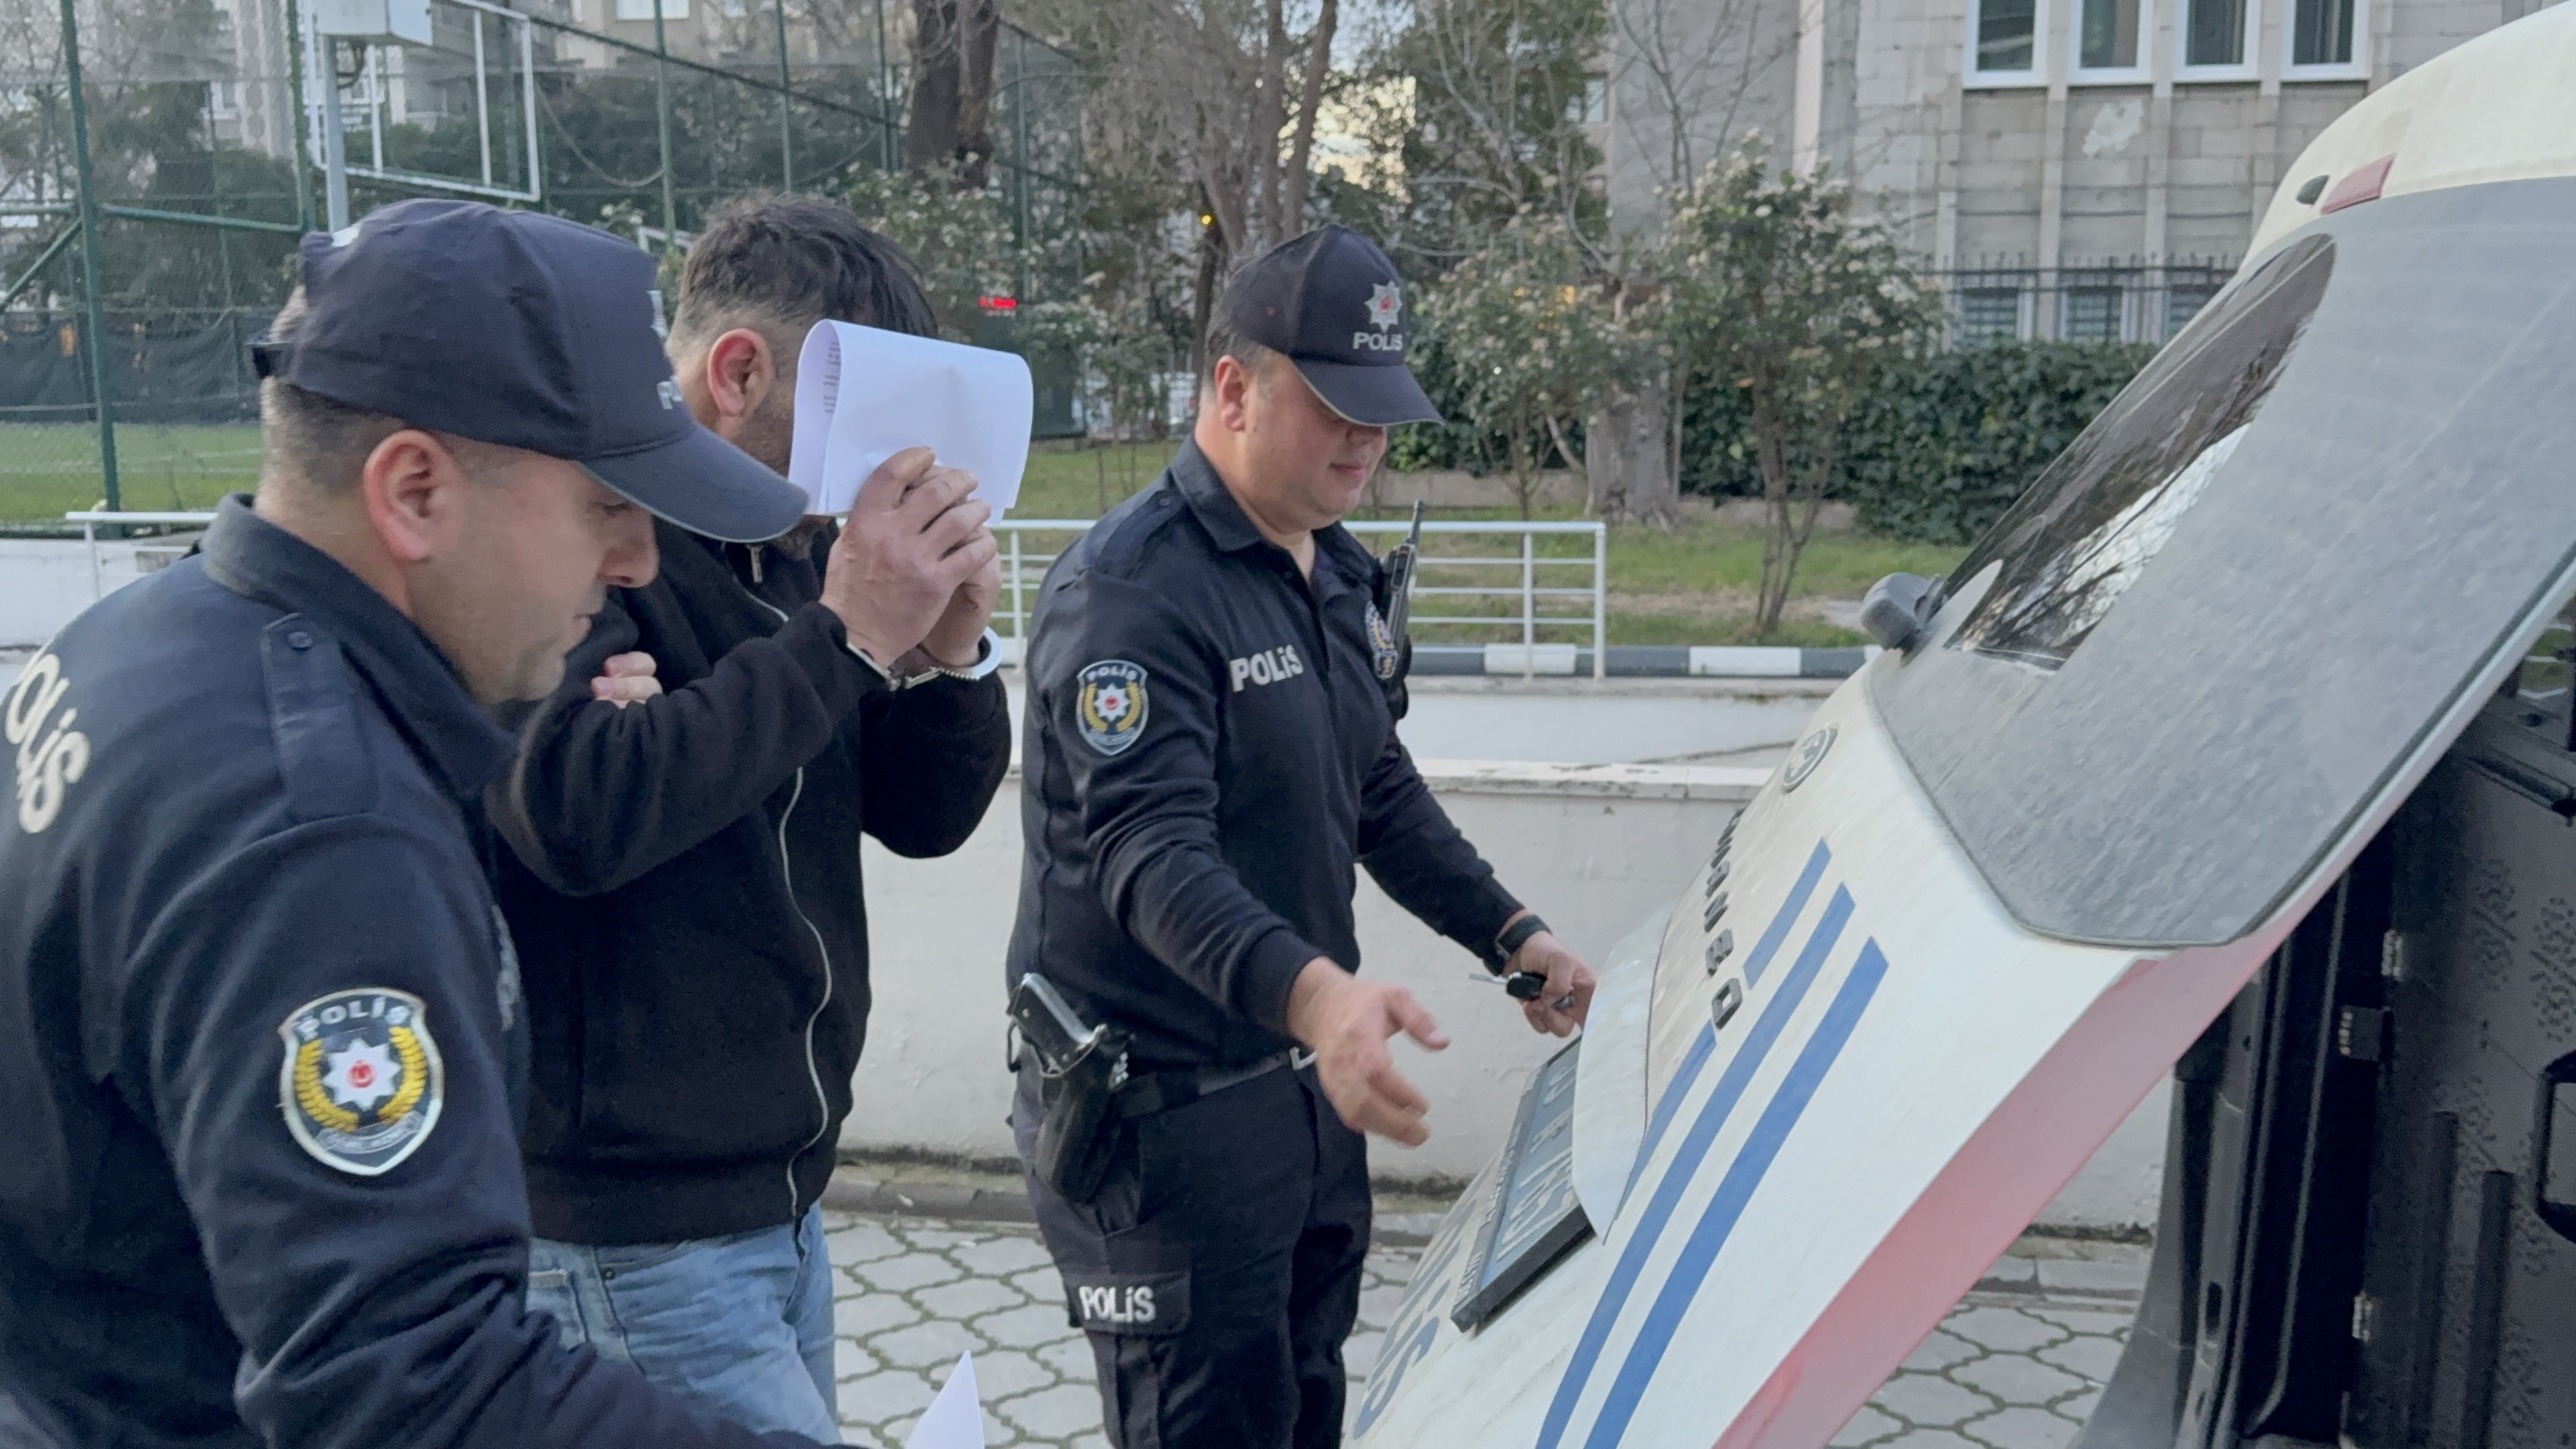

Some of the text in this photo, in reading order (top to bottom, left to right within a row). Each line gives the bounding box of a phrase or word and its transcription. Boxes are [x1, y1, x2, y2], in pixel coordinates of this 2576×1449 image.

[1353, 332, 1404, 351] POLİS
[1229, 644, 1304, 692] POLİS
[6, 648, 91, 834] OLİS
[295, 995, 412, 1041] POLİS
[1079, 1285, 1156, 1323] POLİS
